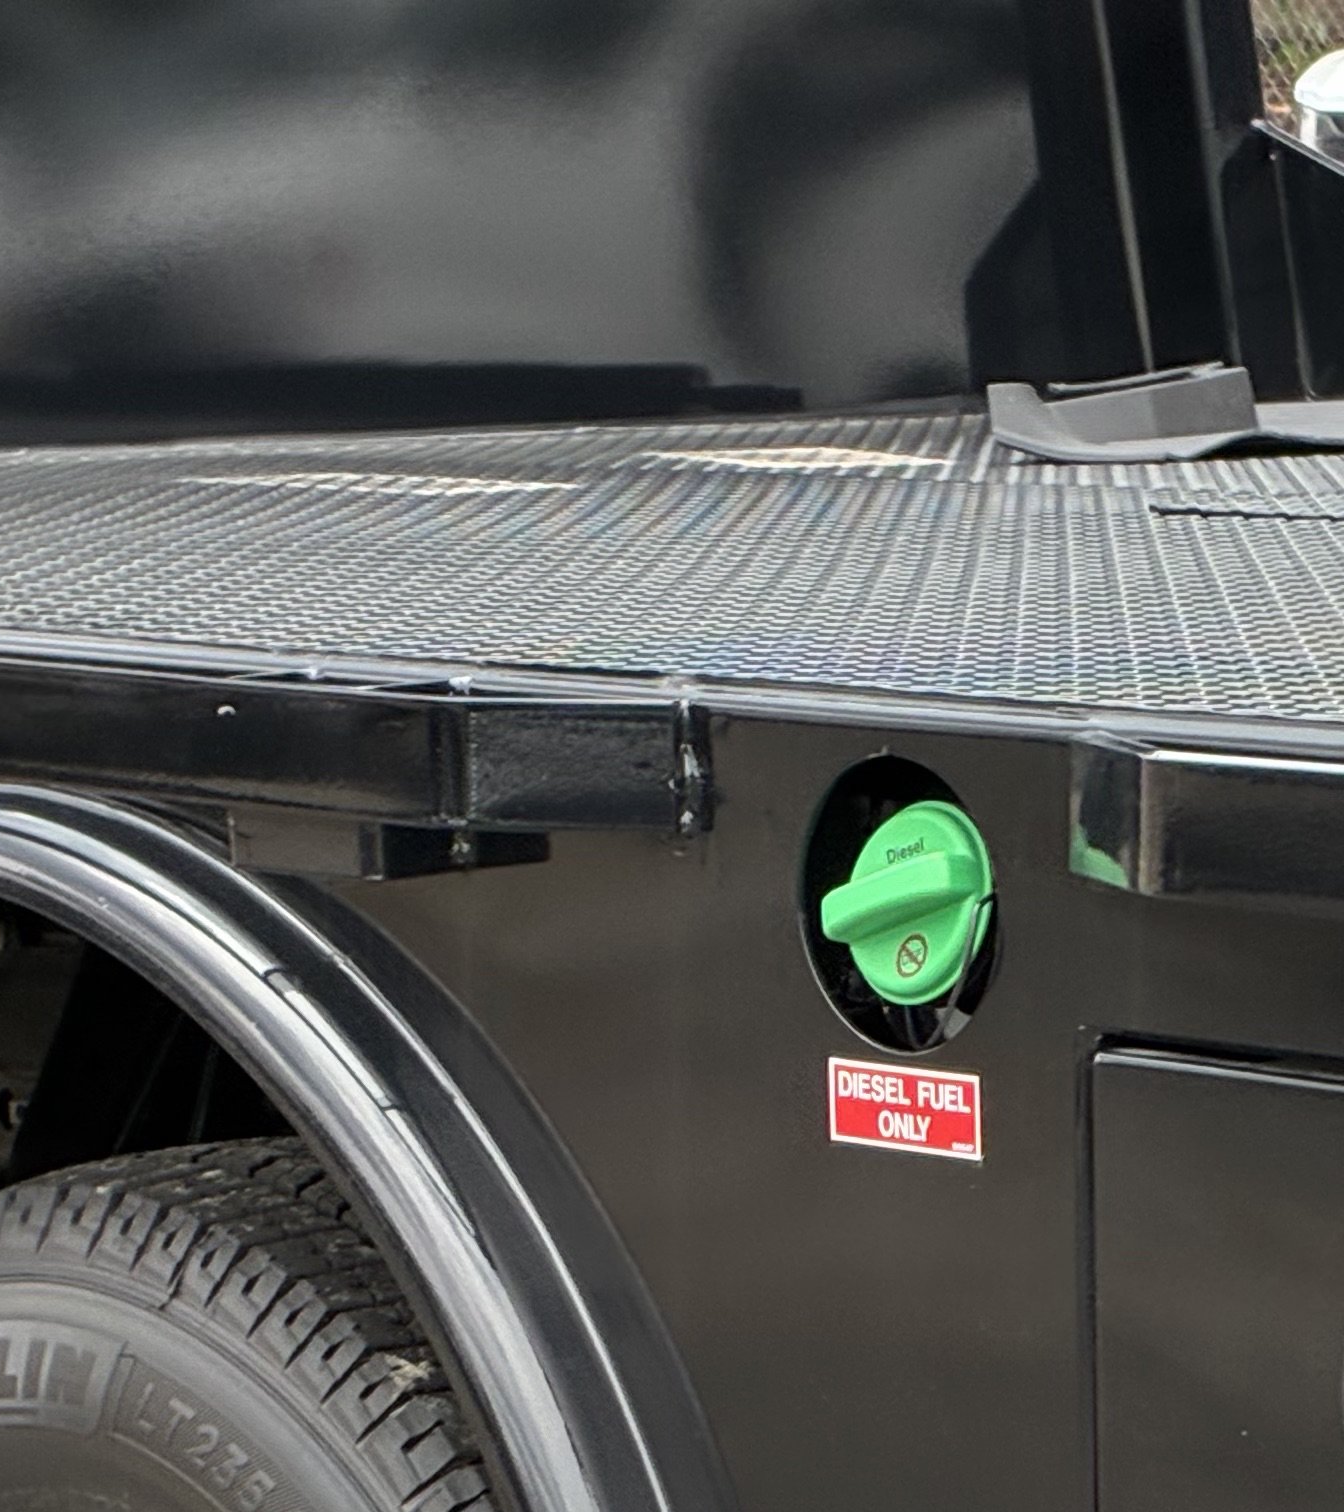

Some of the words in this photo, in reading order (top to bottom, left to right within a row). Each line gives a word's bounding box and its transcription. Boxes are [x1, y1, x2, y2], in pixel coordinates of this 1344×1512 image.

[886, 837, 925, 864] Diesel
[837, 1070, 912, 1106] DIESEL
[917, 1080, 972, 1114] FUEL
[878, 1109, 932, 1142] ONLY
